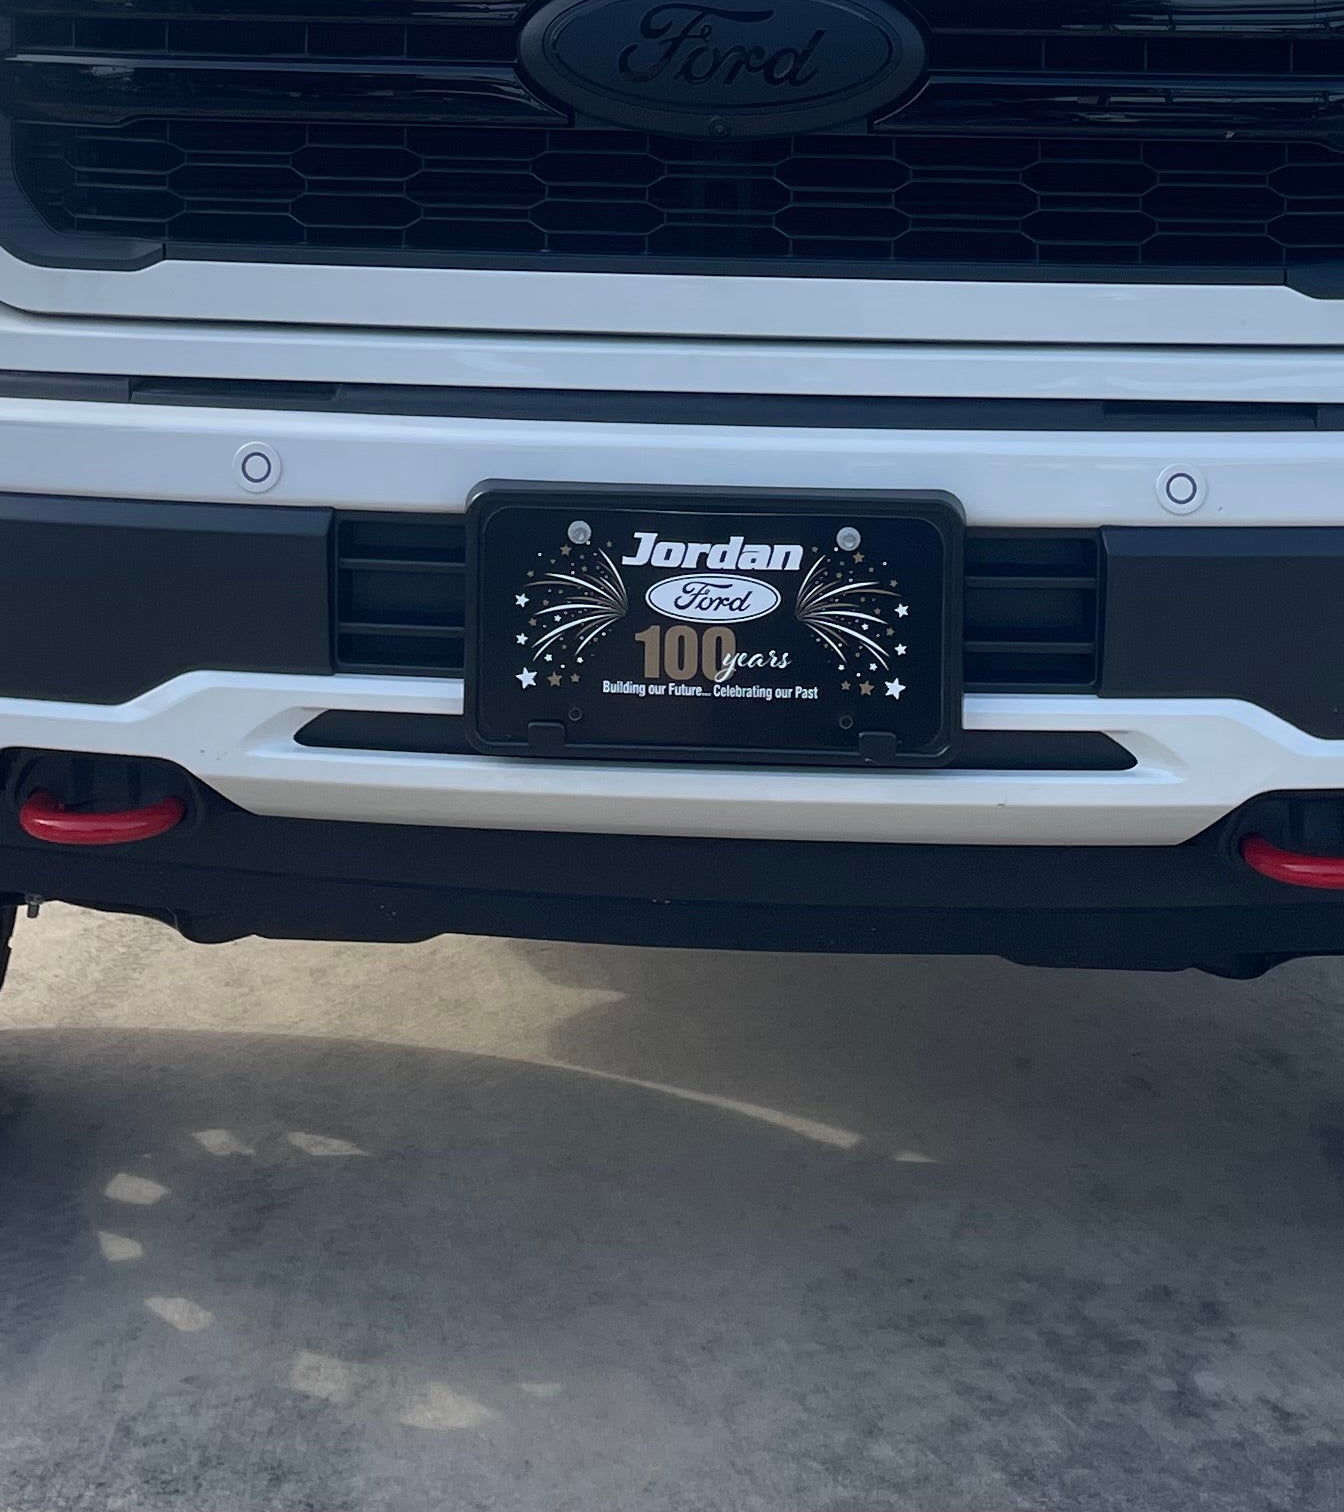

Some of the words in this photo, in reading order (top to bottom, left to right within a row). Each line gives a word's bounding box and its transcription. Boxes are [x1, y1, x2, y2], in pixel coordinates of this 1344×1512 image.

[617, 1, 827, 88] Ford
[621, 531, 804, 571] Jordan
[673, 581, 753, 612] Ford
[634, 624, 736, 681] 100
[714, 649, 793, 683] years
[602, 680, 646, 697] Building
[648, 684, 666, 696] our
[713, 684, 772, 701] Celebrating
[775, 687, 792, 699] our
[795, 686, 818, 700] Past
